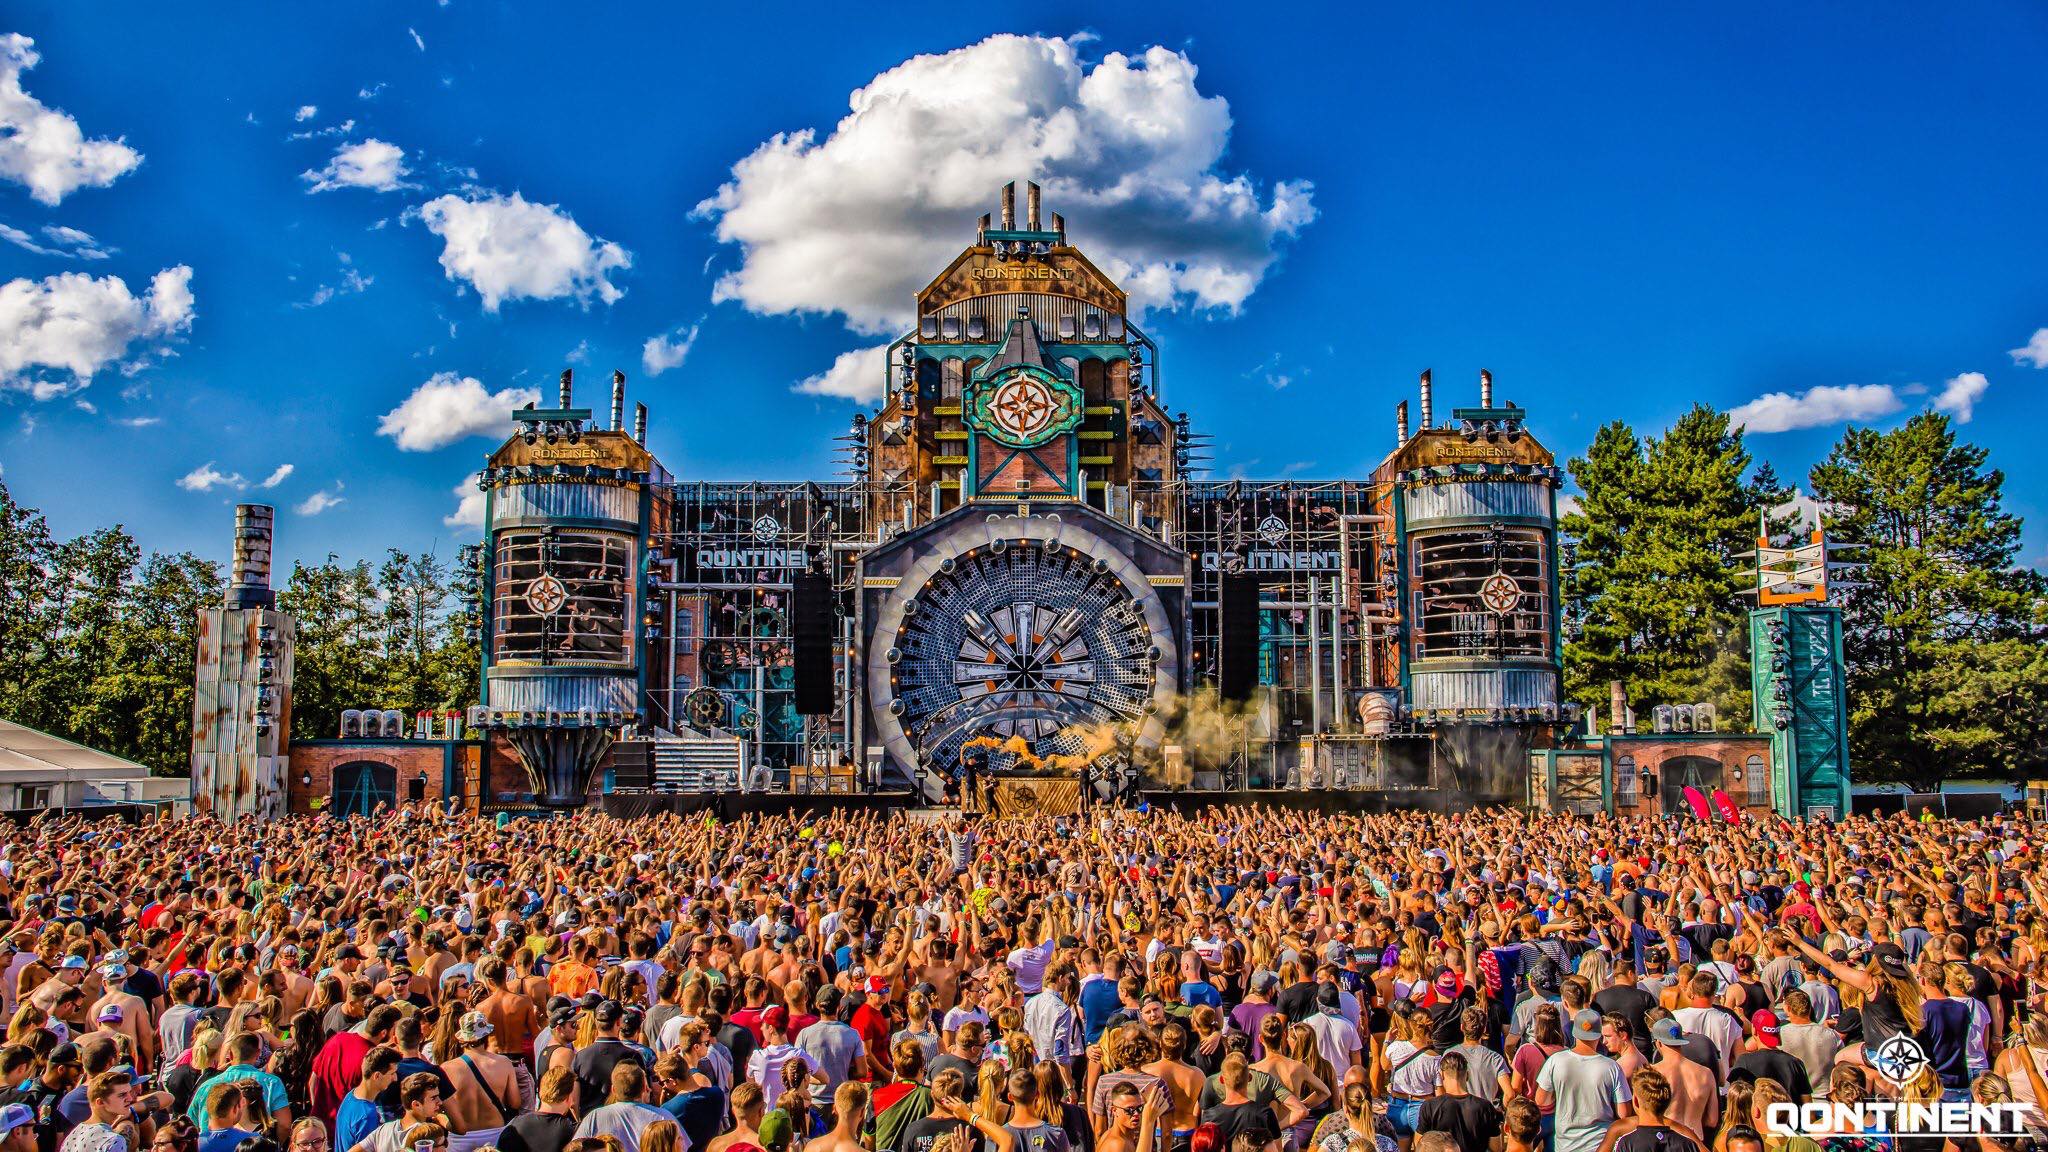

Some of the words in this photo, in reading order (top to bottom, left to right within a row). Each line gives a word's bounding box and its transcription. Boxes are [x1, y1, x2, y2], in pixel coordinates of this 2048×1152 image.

[971, 268, 1073, 280] QONTINENT
[531, 449, 609, 460] QONTINENT
[1436, 447, 1512, 457] QONTINENT
[697, 550, 808, 569] QONTINE
[1201, 551, 1341, 571] QTINENT
